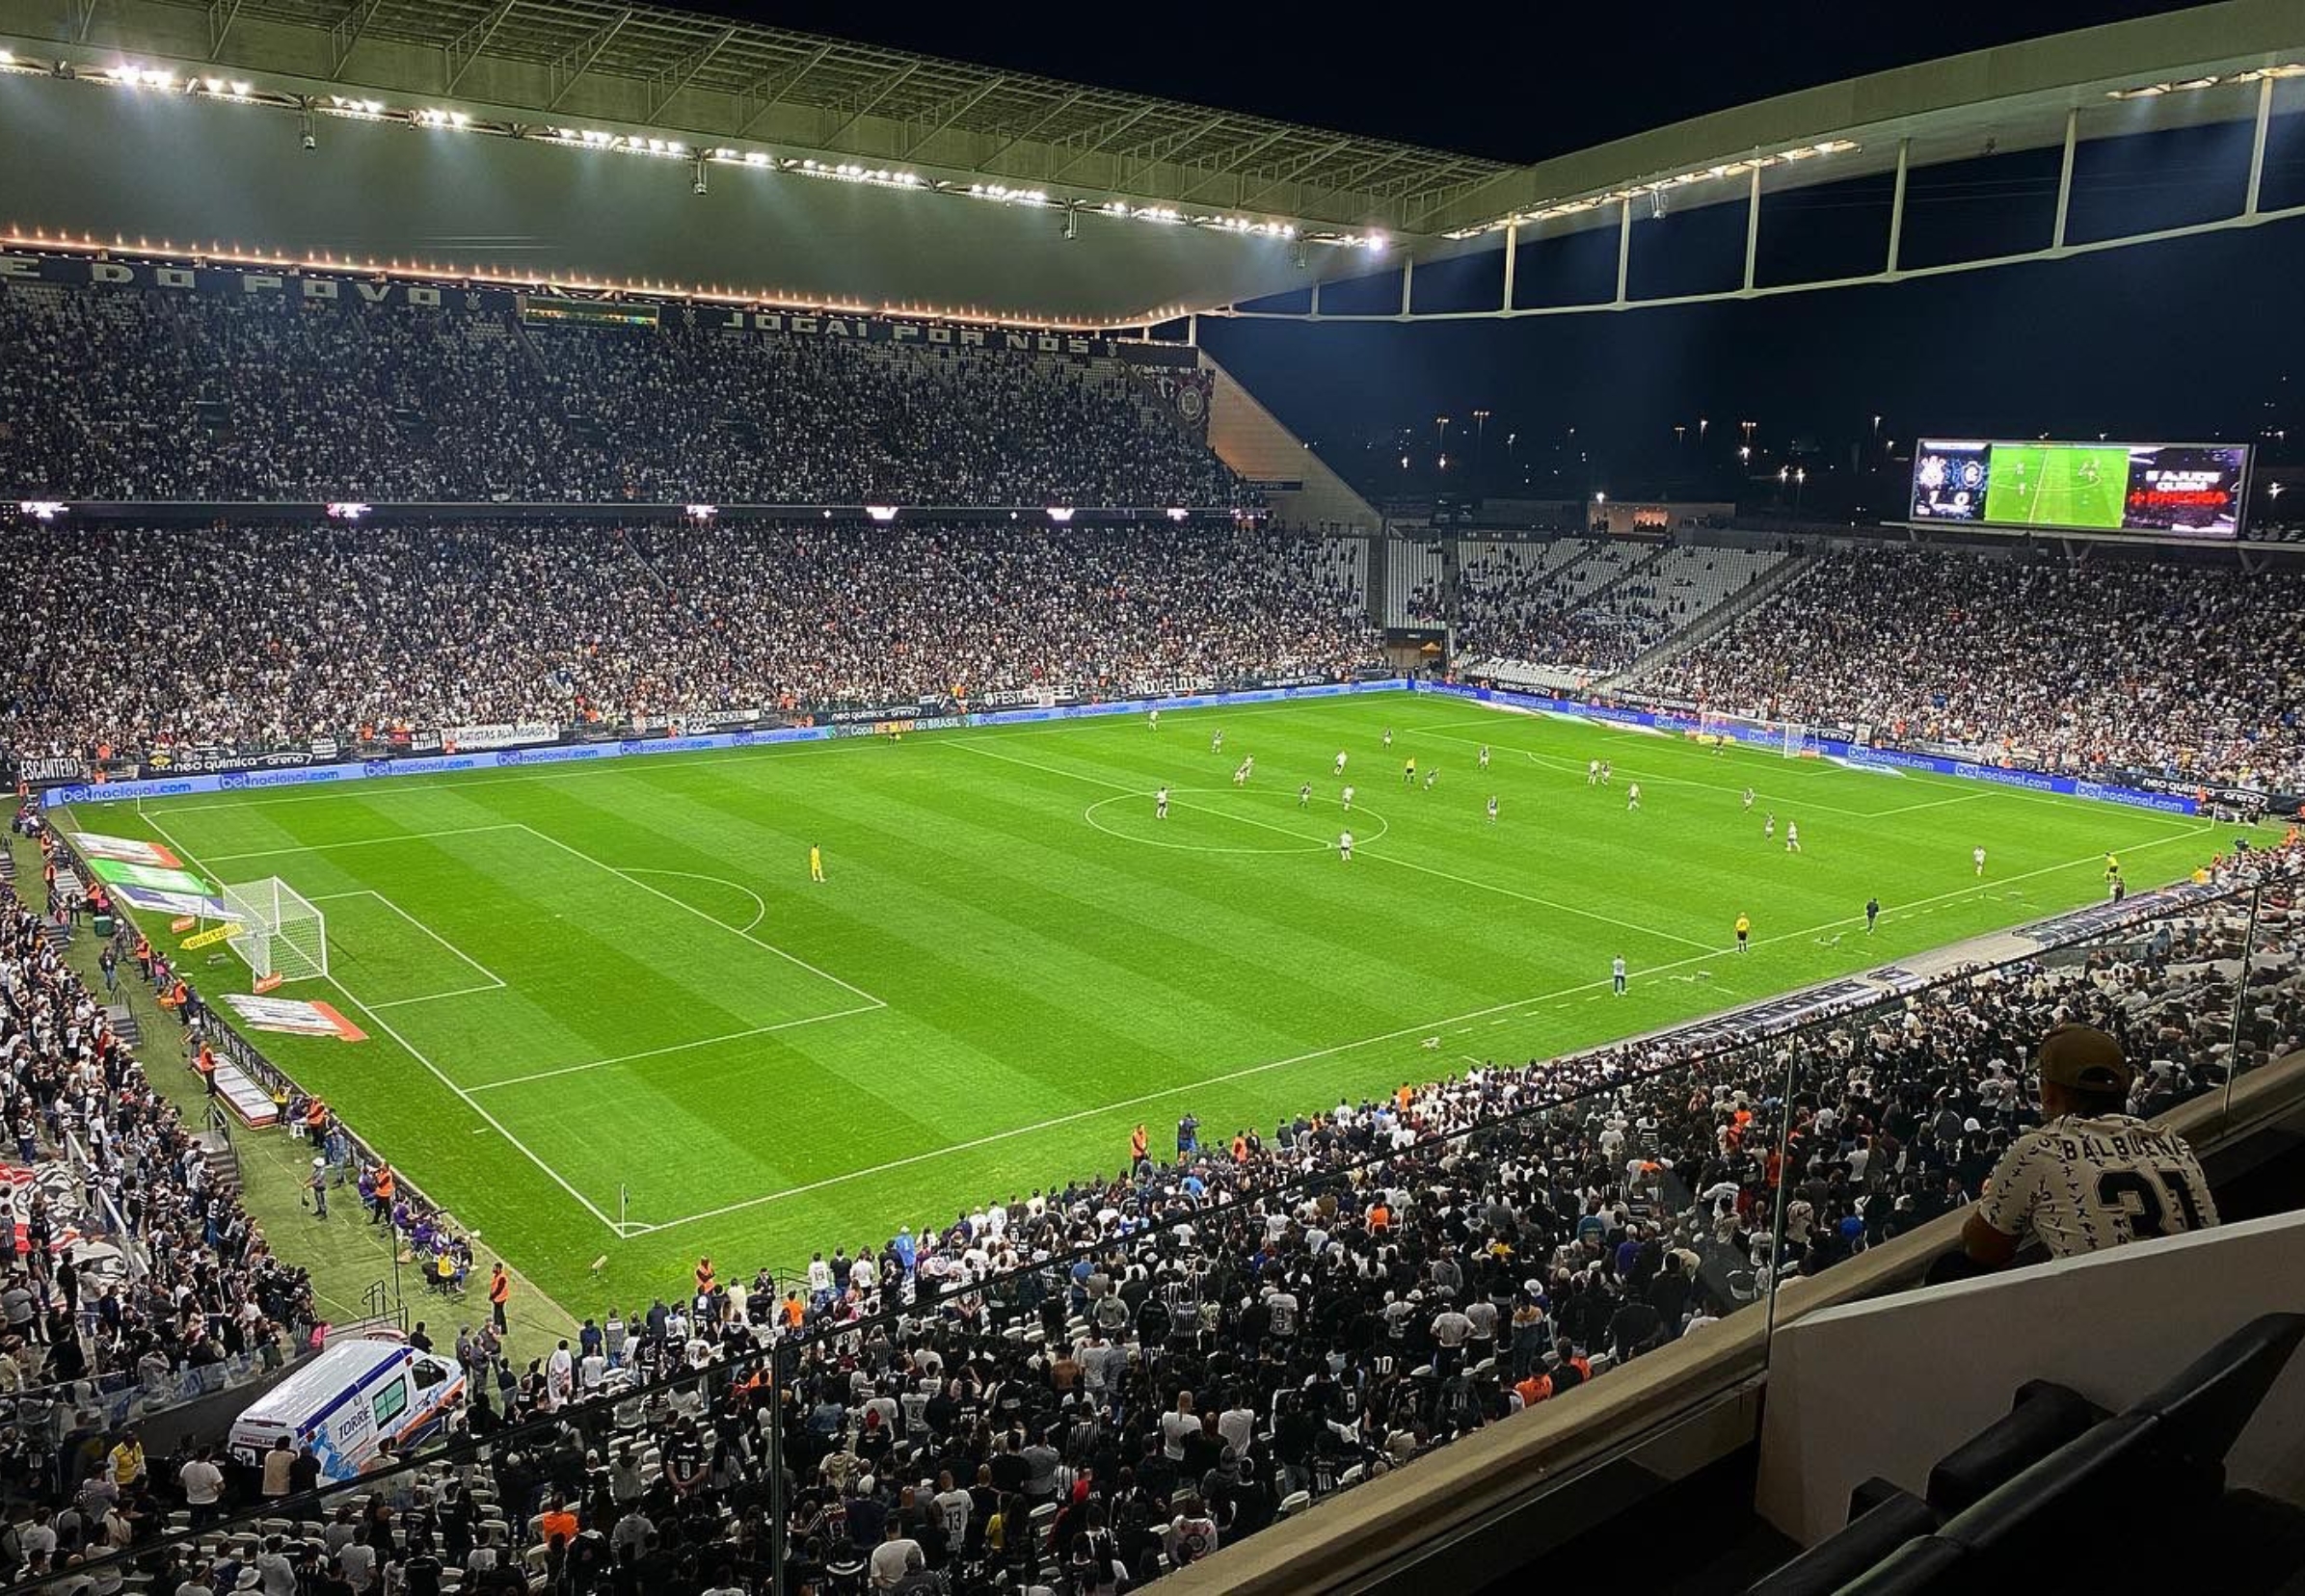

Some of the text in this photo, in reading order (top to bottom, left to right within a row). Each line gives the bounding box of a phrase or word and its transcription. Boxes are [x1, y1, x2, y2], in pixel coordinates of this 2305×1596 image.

[93, 263, 196, 288] DO
[243, 275, 442, 306] POVO
[722, 311, 868, 337] JOGAI
[893, 325, 984, 346] POR
[851, 725, 873, 736] Copa
[874, 720, 914, 734] BENO
[927, 718, 960, 730] BRASIL
[20, 757, 78, 781] ESCANTEIO
[174, 760, 202, 772] neo
[221, 771, 339, 789] betnacional.com
[2142, 777, 2166, 789] neo
[62, 782, 191, 803] betnacional.com
[2077, 779, 2184, 812] betnacional.com
[1374, 1356, 1393, 1374] 10
[1346, 1393, 1356, 1413] 9
[338, 1404, 371, 1440] TORRE
[239, 1436, 276, 1447] AMBULAN
[946, 1510, 961, 1530] 13
